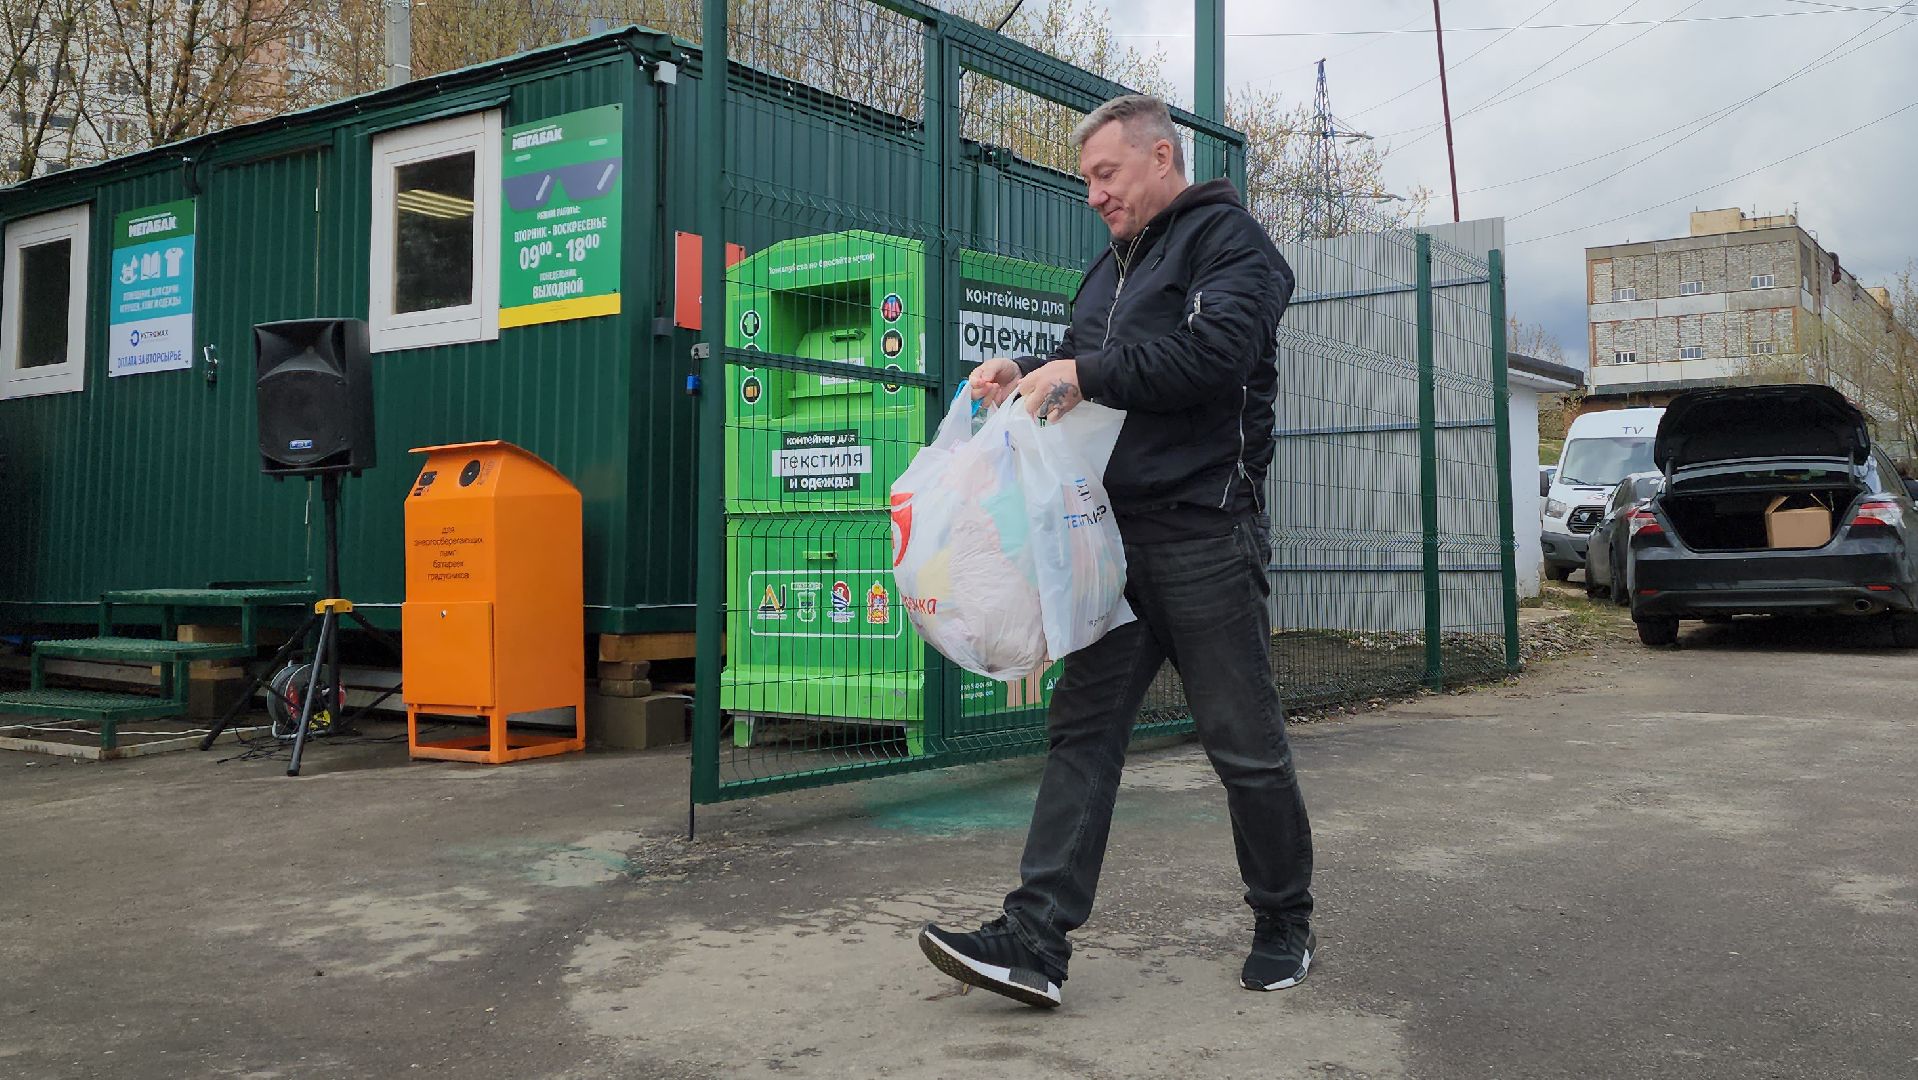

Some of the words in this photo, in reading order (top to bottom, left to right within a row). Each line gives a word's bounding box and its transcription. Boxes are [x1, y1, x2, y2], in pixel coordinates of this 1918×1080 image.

[511, 128, 563, 150] МЕГАБАК
[514, 227, 547, 243] ВТОРНИК
[552, 216, 608, 236] ВОСКРЕСЕНЬЕ
[532, 277, 584, 299] ВЫХОДНОЙ
[965, 287, 1039, 312] контейнер
[1041, 299, 1065, 317] для
[786, 433, 836, 446] контейнер
[837, 434, 856, 444] для
[1621, 426, 1644, 435] TV
[789, 477, 798, 489] и
[800, 476, 854, 491] одежды
